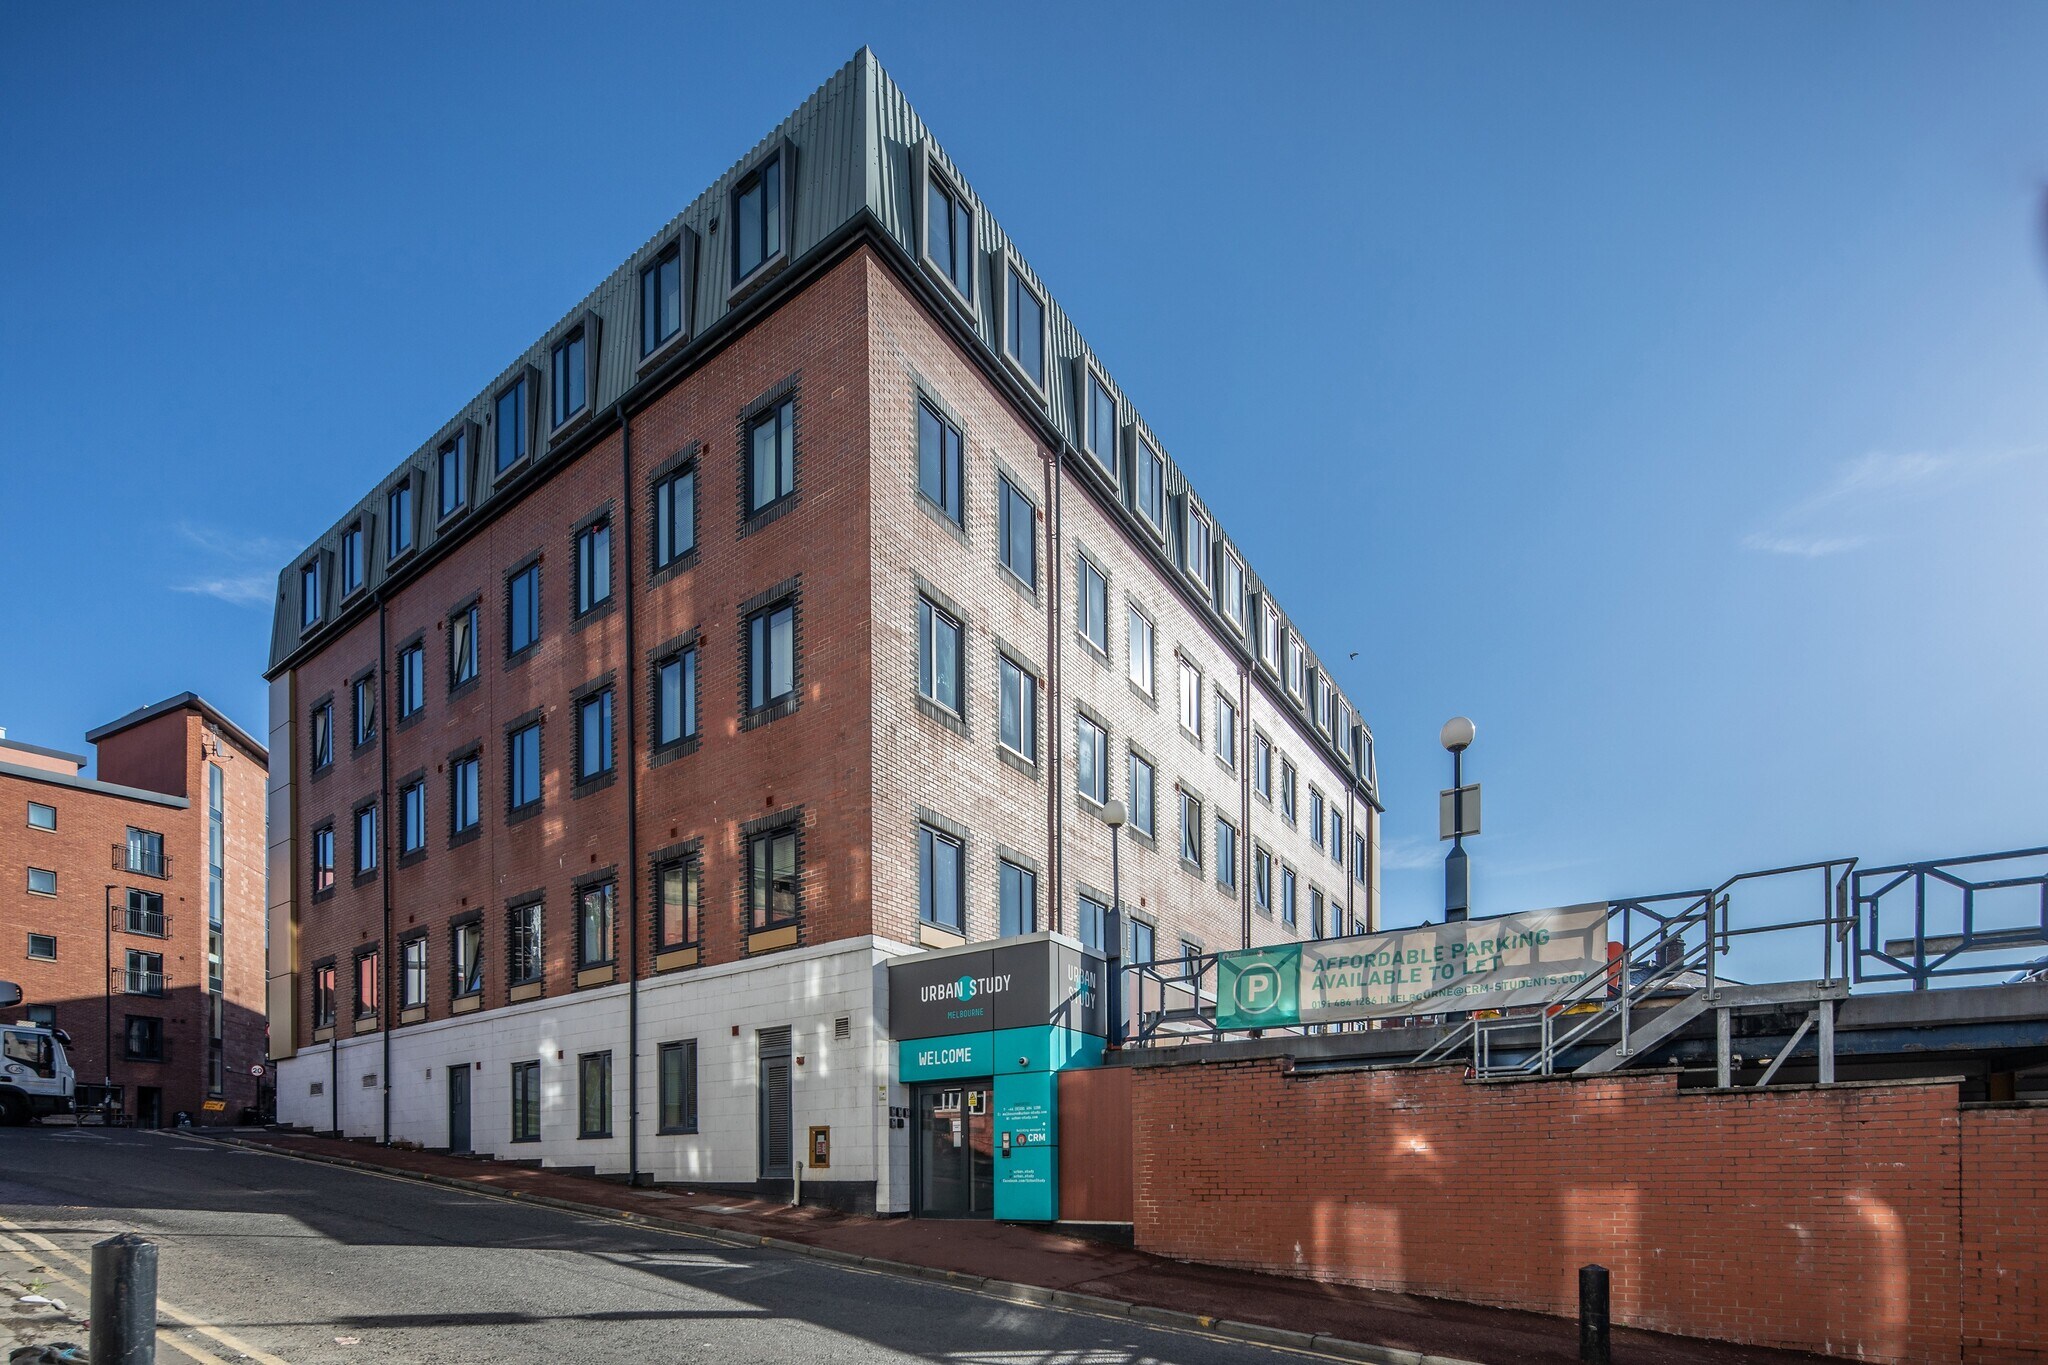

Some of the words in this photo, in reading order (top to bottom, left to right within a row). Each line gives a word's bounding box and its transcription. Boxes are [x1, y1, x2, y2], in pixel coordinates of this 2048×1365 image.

[1312, 946, 1444, 972] AFFORDABLE
[1451, 929, 1550, 959] PARKING
[1067, 963, 1096, 989] URBAN
[1312, 968, 1422, 990] AVAILABLE
[1429, 963, 1455, 981] TO
[1463, 955, 1502, 975] LET
[921, 981, 964, 1003] URBAN
[969, 974, 1011, 996] STUDY
[1068, 986, 1096, 1009] STUDY
[1248, 975, 1269, 1002] P
[947, 1007, 984, 1020] MELBOURNE
[918, 1047, 972, 1066] WELCOME
[1027, 1133, 1046, 1142] CRM
